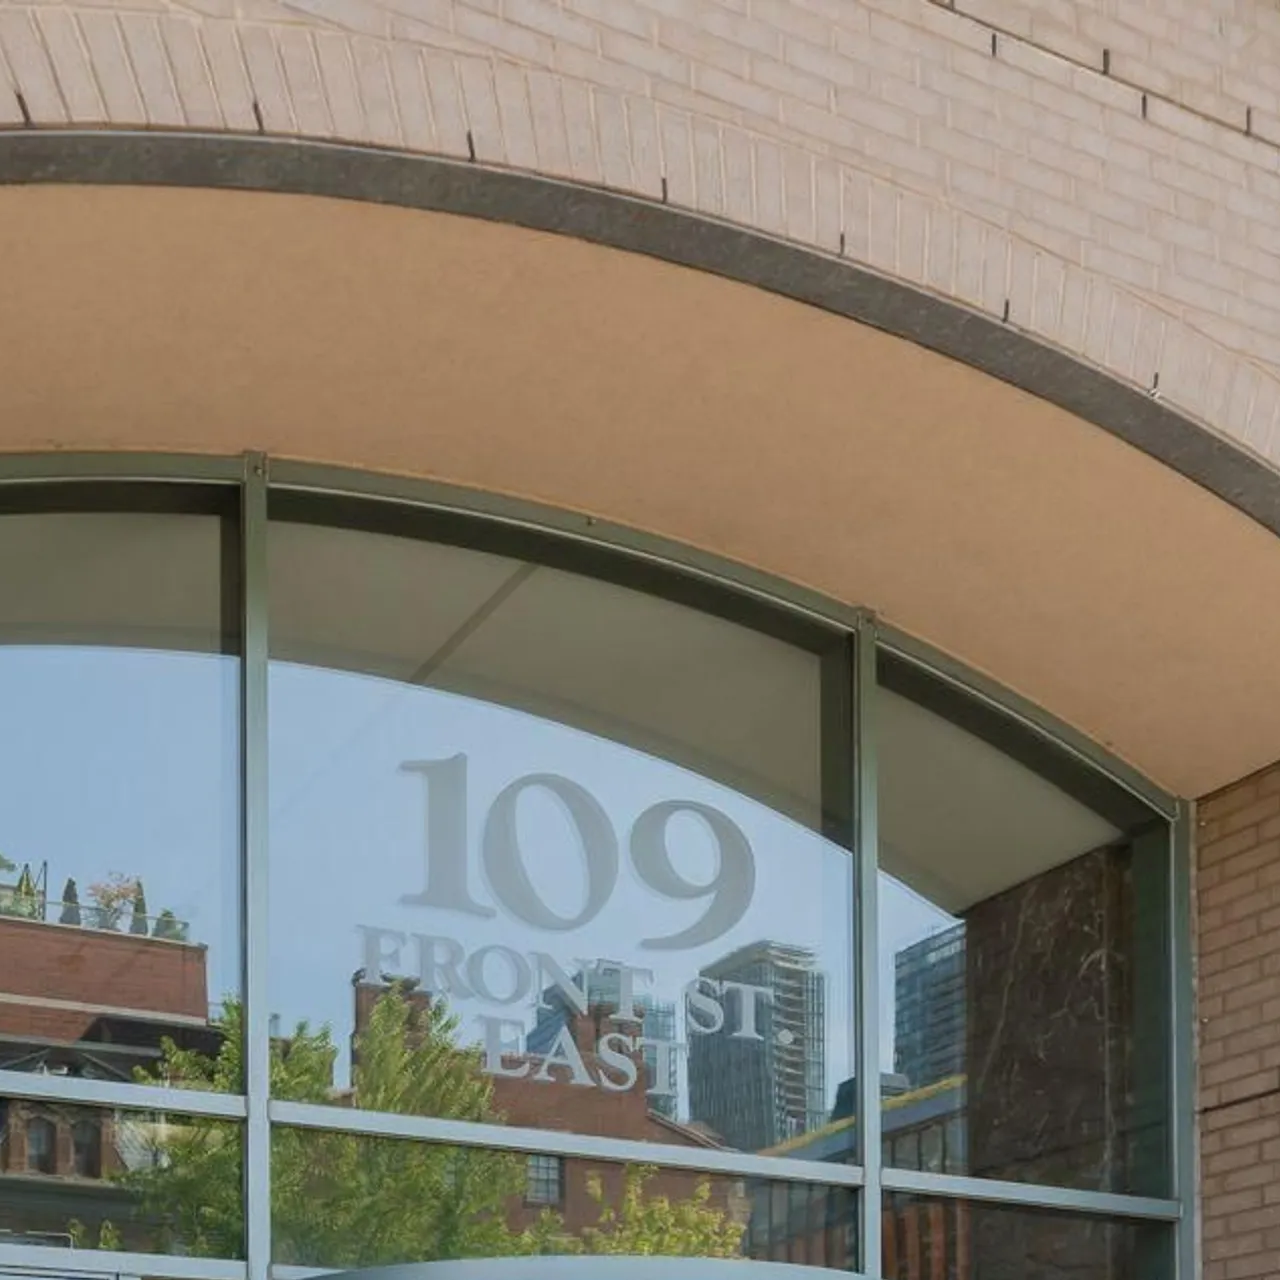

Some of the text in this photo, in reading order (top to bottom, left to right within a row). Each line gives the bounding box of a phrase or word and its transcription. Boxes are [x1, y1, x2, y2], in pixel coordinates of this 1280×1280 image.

[397, 752, 756, 951] 109
[355, 923, 795, 1044] FRONT ST.
[476, 1014, 687, 1096] EAST
